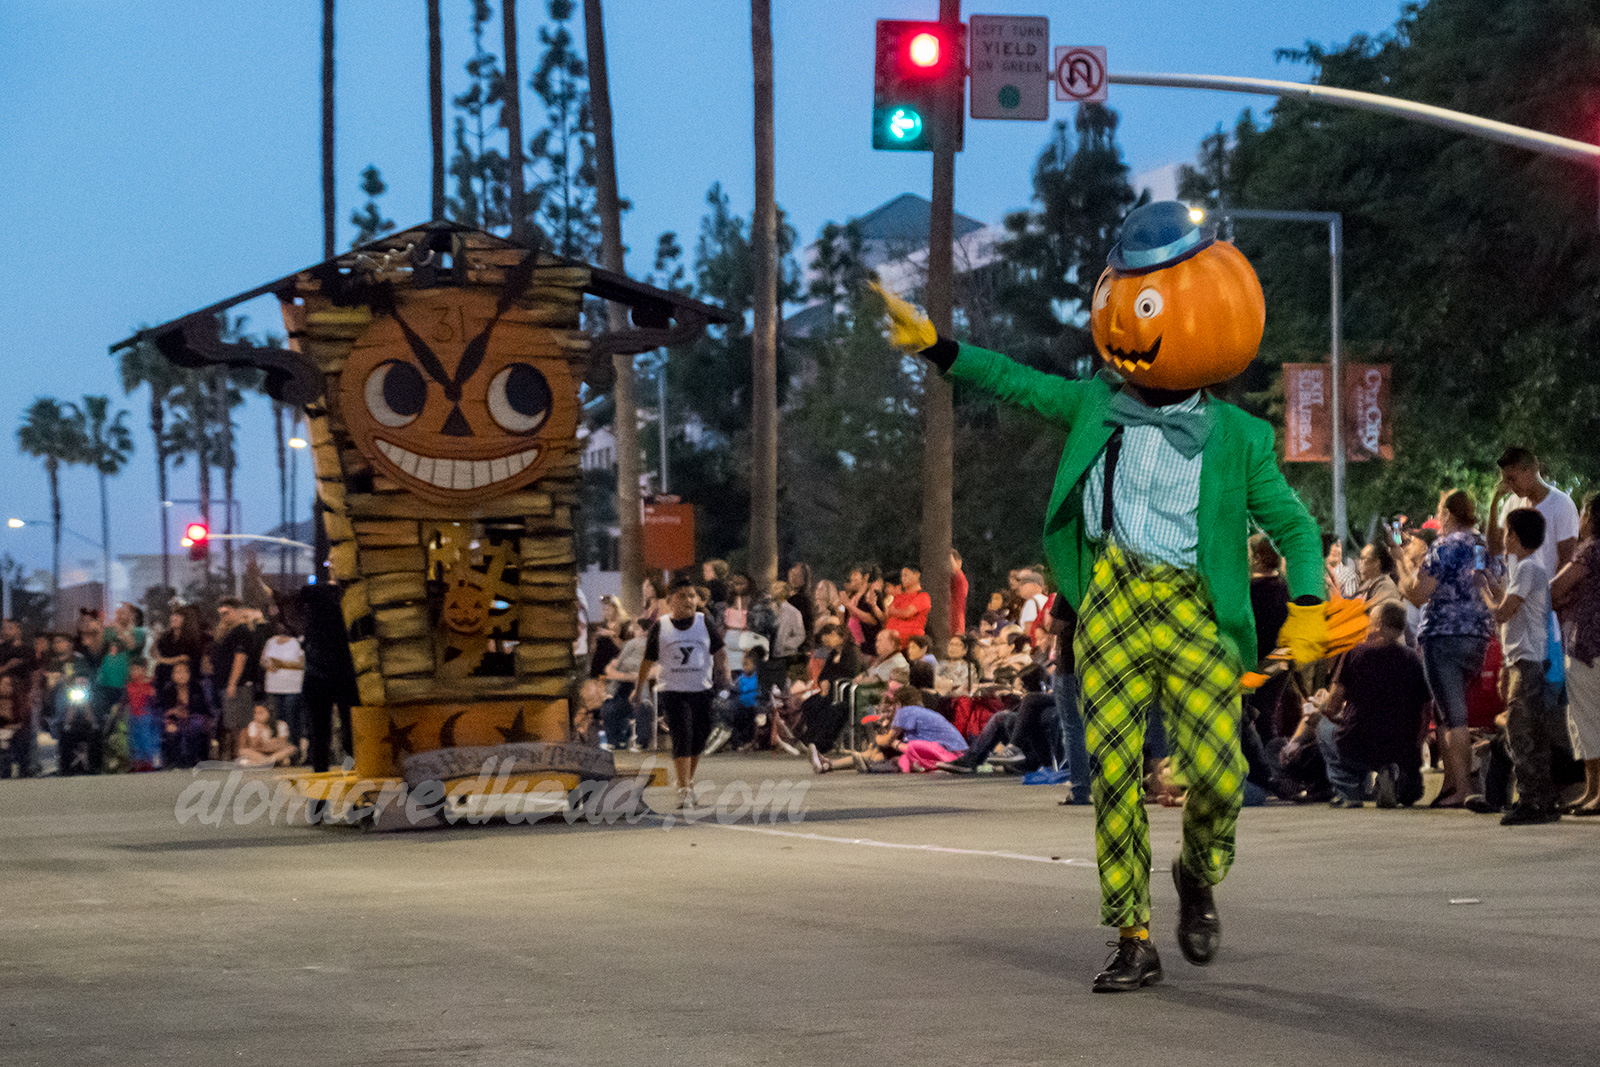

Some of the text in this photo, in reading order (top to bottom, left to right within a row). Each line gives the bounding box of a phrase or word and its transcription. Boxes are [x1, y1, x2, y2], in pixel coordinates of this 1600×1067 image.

[976, 24, 1044, 37] LEFT TURN
[983, 41, 1037, 56] YIELD
[977, 61, 1042, 72] ON GREEN
[431, 304, 466, 343] 31
